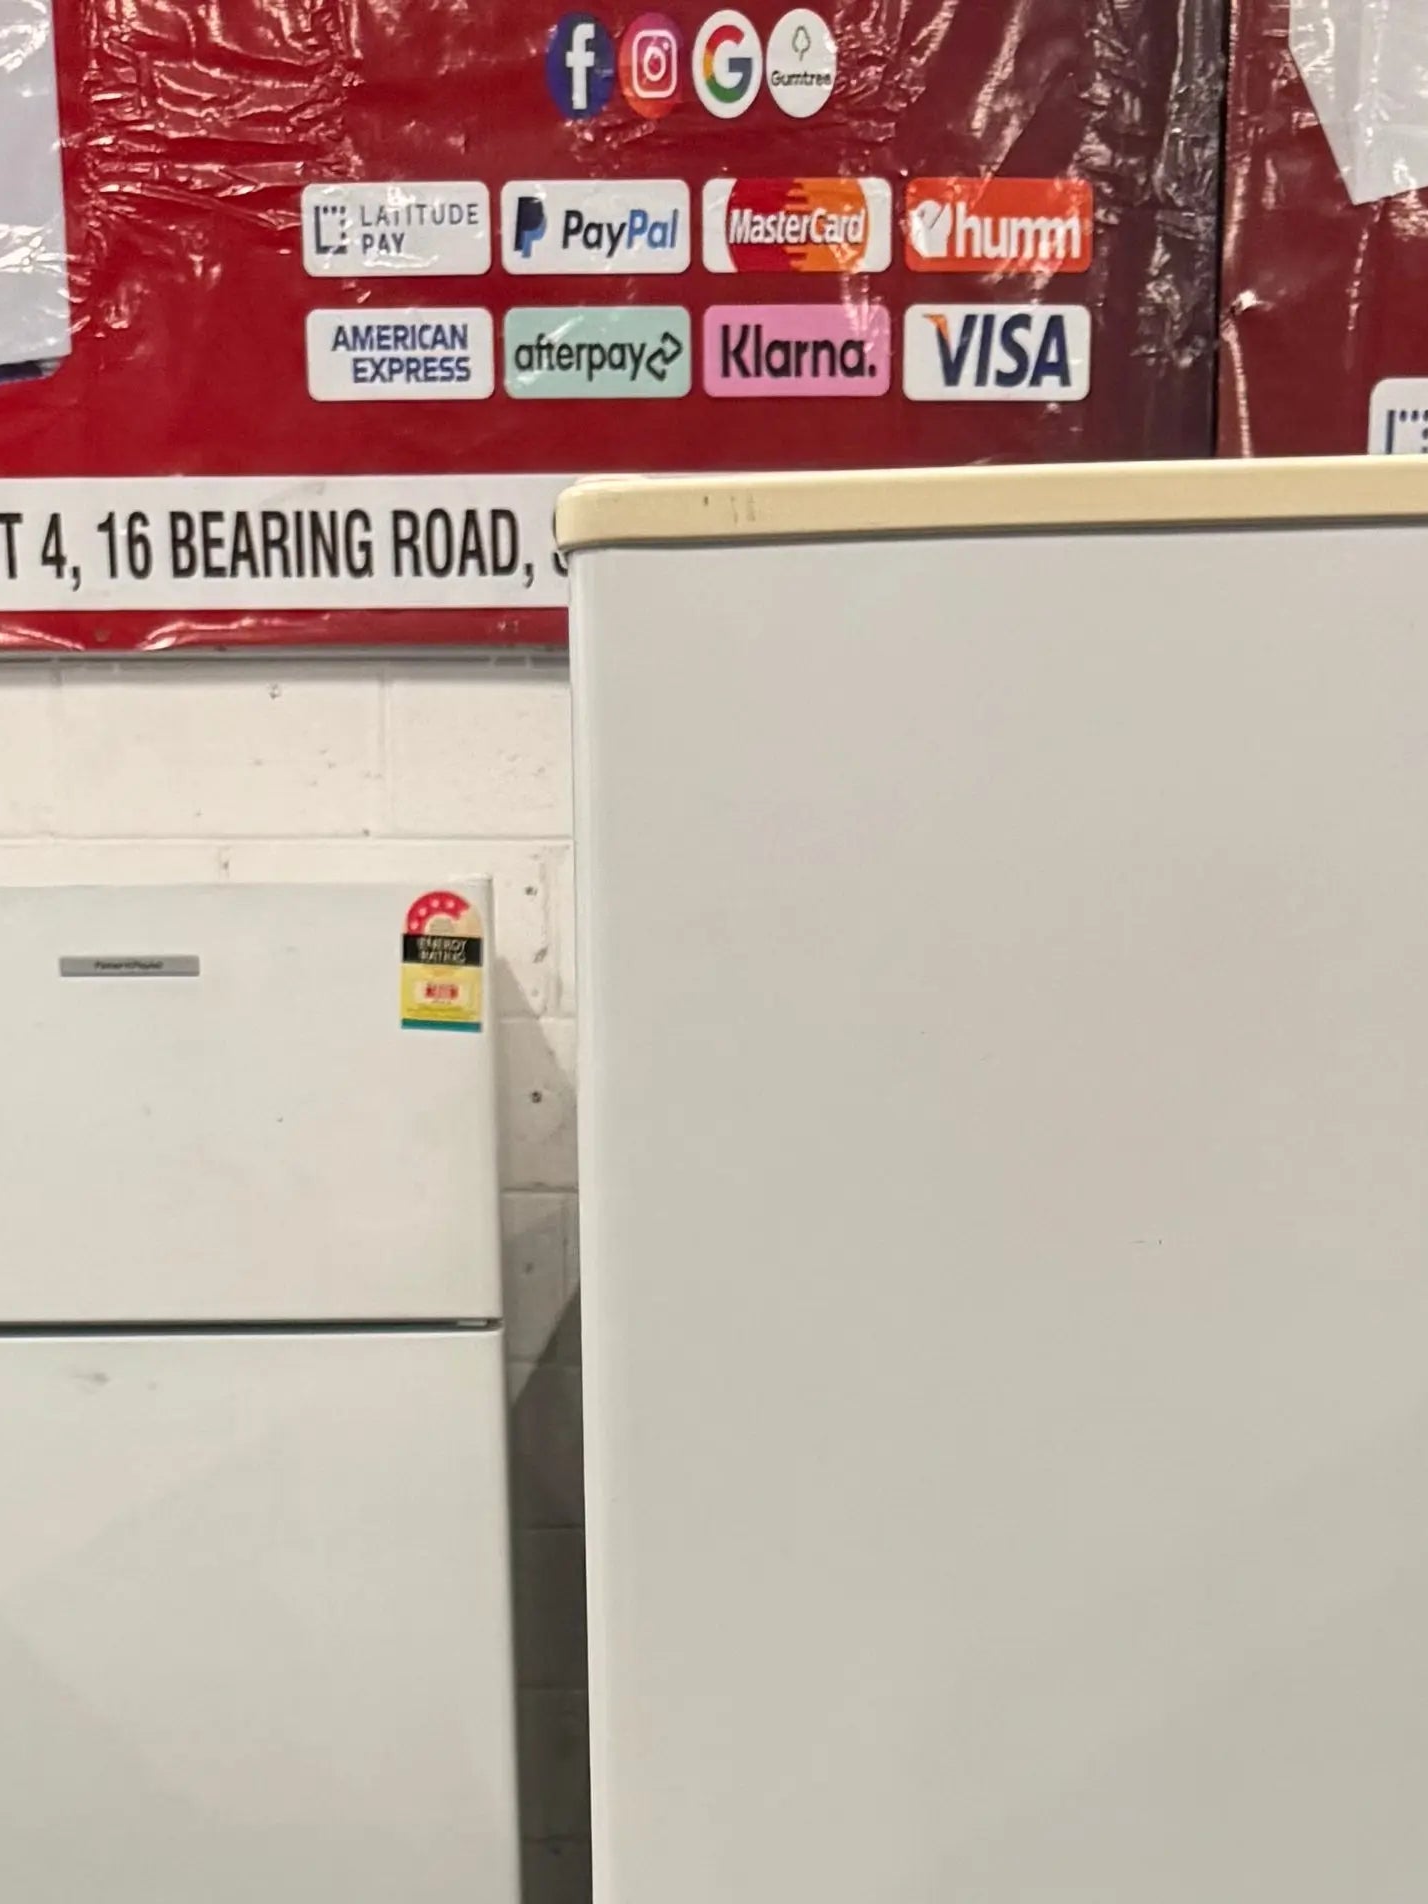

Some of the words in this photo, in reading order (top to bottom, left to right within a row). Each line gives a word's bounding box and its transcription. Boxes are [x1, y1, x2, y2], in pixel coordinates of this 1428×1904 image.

[771, 70, 831, 86] Gumtree
[360, 204, 479, 226] LATITUDE
[562, 209, 678, 257] PayPal
[729, 208, 866, 244] MasterCard
[956, 202, 1081, 259] humm
[362, 233, 405, 254] PAY
[332, 324, 468, 351] AMERICAN
[515, 334, 646, 381] afterpay
[722, 324, 876, 378] Klarna.
[924, 314, 1071, 387] VISA
[352, 357, 470, 383] EXPRESS
[41, 511, 81, 590] 4,
[97, 510, 151, 578] 16
[171, 509, 372, 578] BEARING
[393, 508, 534, 588] ROAD,
